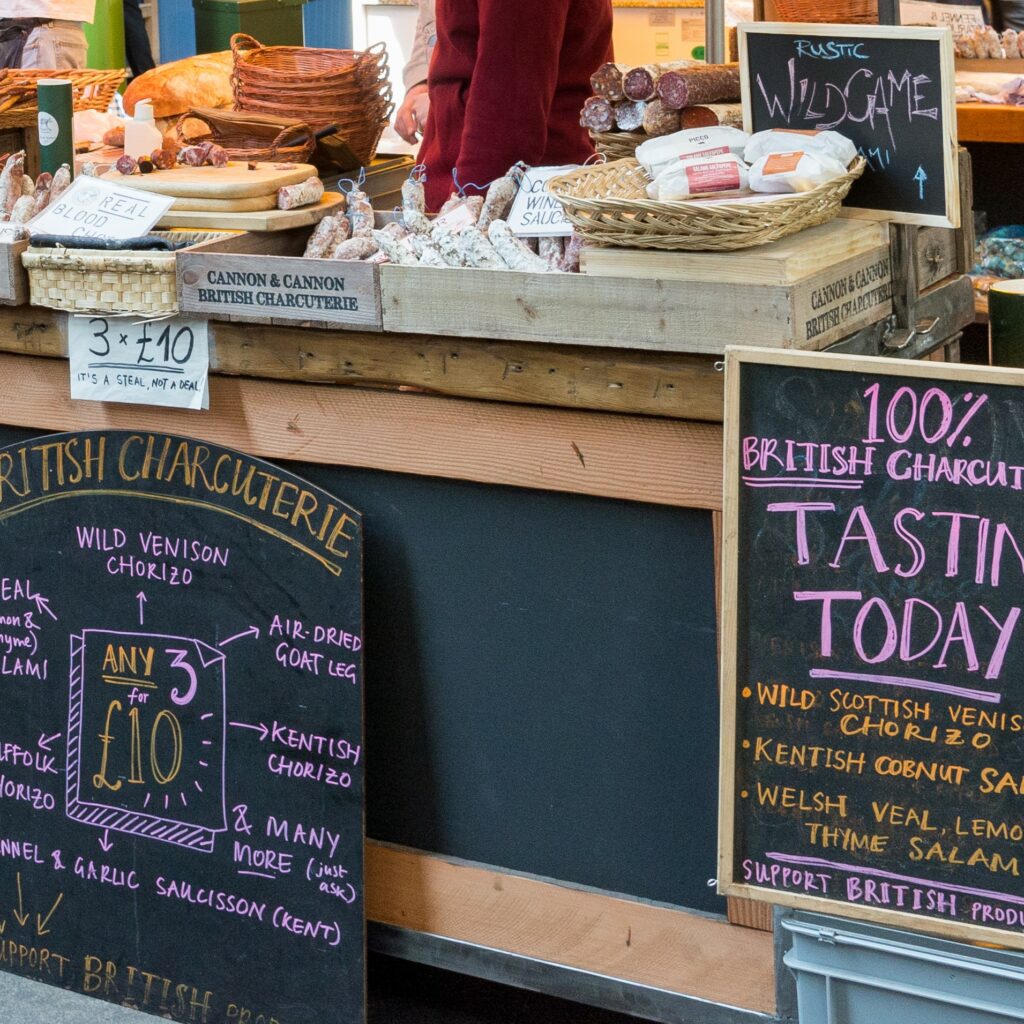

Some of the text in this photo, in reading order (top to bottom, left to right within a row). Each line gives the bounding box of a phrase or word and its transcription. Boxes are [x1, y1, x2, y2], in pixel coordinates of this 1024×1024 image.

[793, 40, 870, 60] RUSTIC
[52, 204, 109, 228] BLOOD
[98, 196, 150, 218] REAL
[198, 289, 358, 311] BRITISH CHARCUTERIE
[207, 270, 345, 291] CANNON & CANNON
[811, 257, 889, 311] CANNON & CANNON
[88, 317, 110, 356] 3
[136, 322, 194, 365] £10
[805, 306, 841, 341] BRITISH
[77, 372, 97, 381] IT'S
[103, 374, 110, 385] A
[116, 374, 150, 391] STEAL,
[151, 378, 169, 390] NOT
[862, 383, 988, 447] 100%
[742, 437, 1024, 490] BRITISH CHARCUT
[119, 435, 358, 559] CHARCUTERIE
[76, 526, 229, 567] WILD VENISON
[107, 557, 193, 585] CHORIZO
[23, 611, 41, 630] &
[269, 615, 362, 652] AIR-DRIED
[793, 590, 1021, 679] TODAY
[102, 643, 198, 706] ANY 3
[275, 642, 358, 684] GOAT LEG
[127, 687, 150, 704] for
[757, 682, 1024, 732] WILD SCOTTISH VENIS
[92, 699, 183, 791] £10
[270, 721, 361, 765] KENTISH
[840, 713, 991, 749] CHORIZO
[267, 753, 352, 787] CHORIZO
[753, 737, 866, 775] KENTISH
[874, 755, 970, 785] COBNUT
[233, 804, 340, 858] & MANY
[757, 782, 1023, 841] WELSH VEAL, LEMO
[234, 841, 349, 880] MORE (just
[805, 822, 1020, 876] THYME SALAM
[51, 850, 65, 869] &
[74, 857, 139, 889] GARLIC
[156, 877, 266, 921] SAUCISSON
[272, 905, 342, 945] (KENT)
[319, 880, 356, 904] ask)
[742, 859, 832, 893] SUPPORT
[846, 877, 956, 916] BRITISH
[83, 954, 213, 1023] BRITISH
